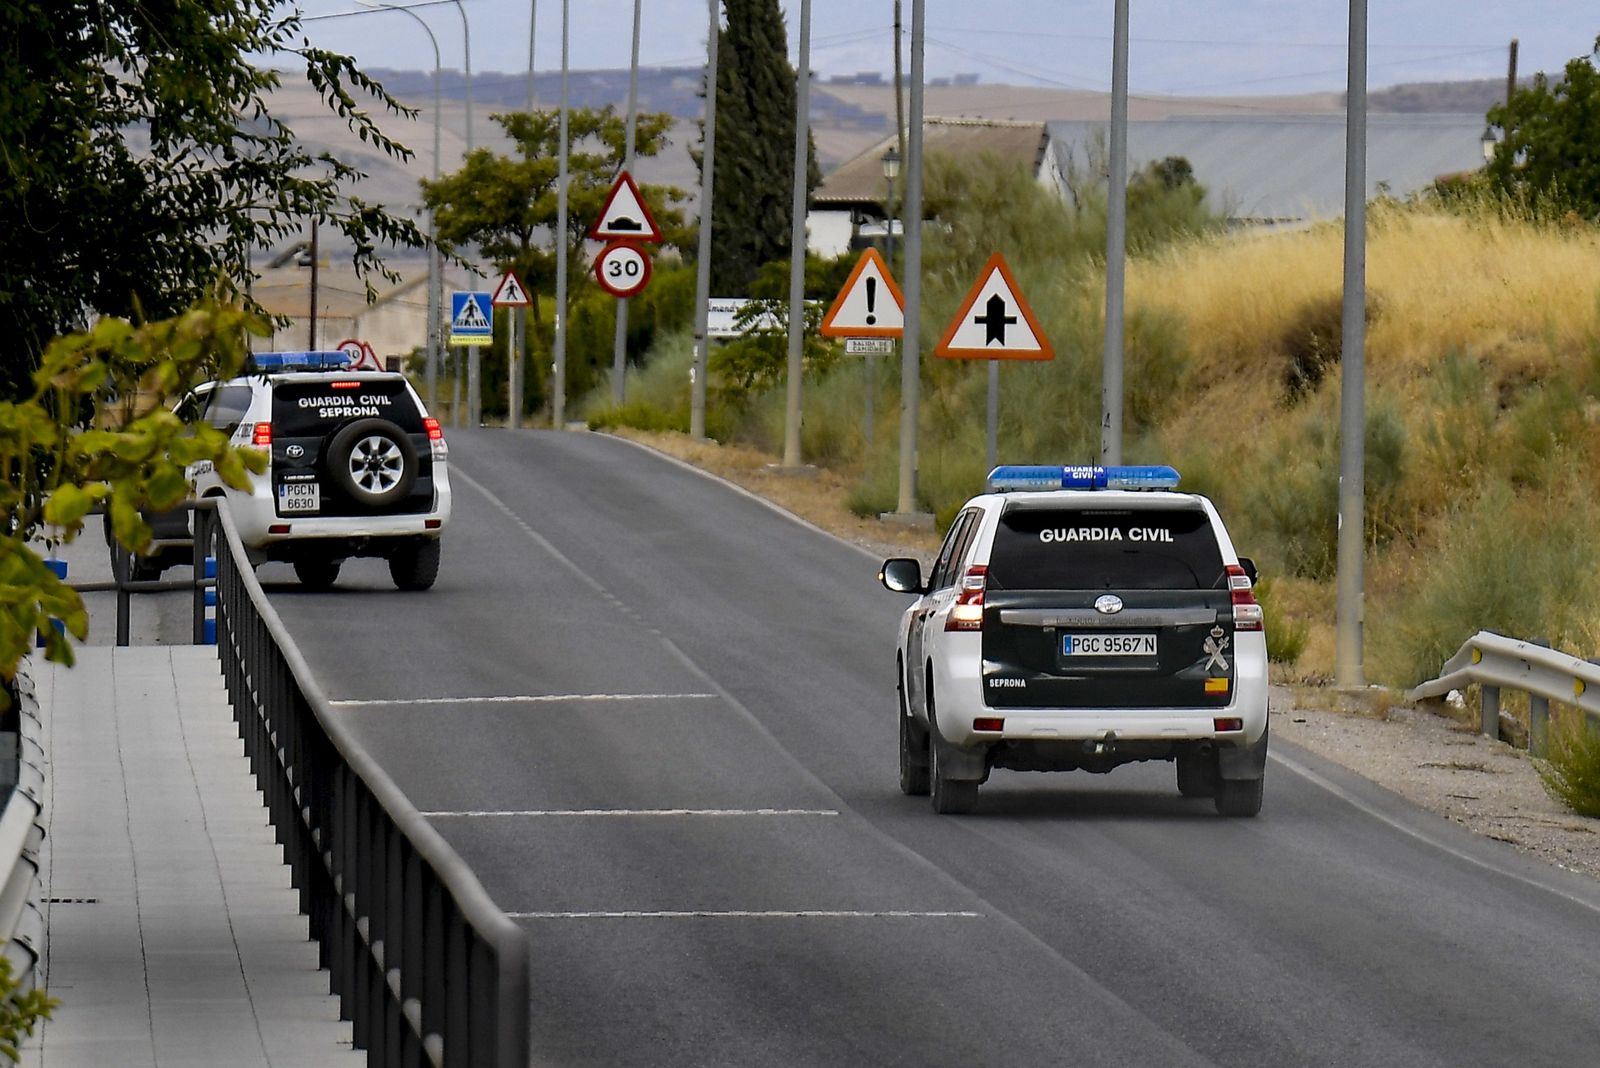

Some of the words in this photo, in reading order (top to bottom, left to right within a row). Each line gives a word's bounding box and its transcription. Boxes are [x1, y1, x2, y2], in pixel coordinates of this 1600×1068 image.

[609, 260, 639, 277] 30
[298, 395, 355, 408] GUARDIA
[359, 395, 392, 405] CIVIL
[319, 406, 380, 418] SEPRONA
[287, 485, 315, 496] PGCN
[287, 498, 314, 509] 6630
[1039, 527, 1123, 543] GUARDIA
[1128, 527, 1174, 543] CIVIL
[1072, 637, 1100, 653] PGC
[1104, 637, 1141, 653] 9567
[1144, 637, 1155, 653] N
[989, 678, 1027, 688] SEPRONA
